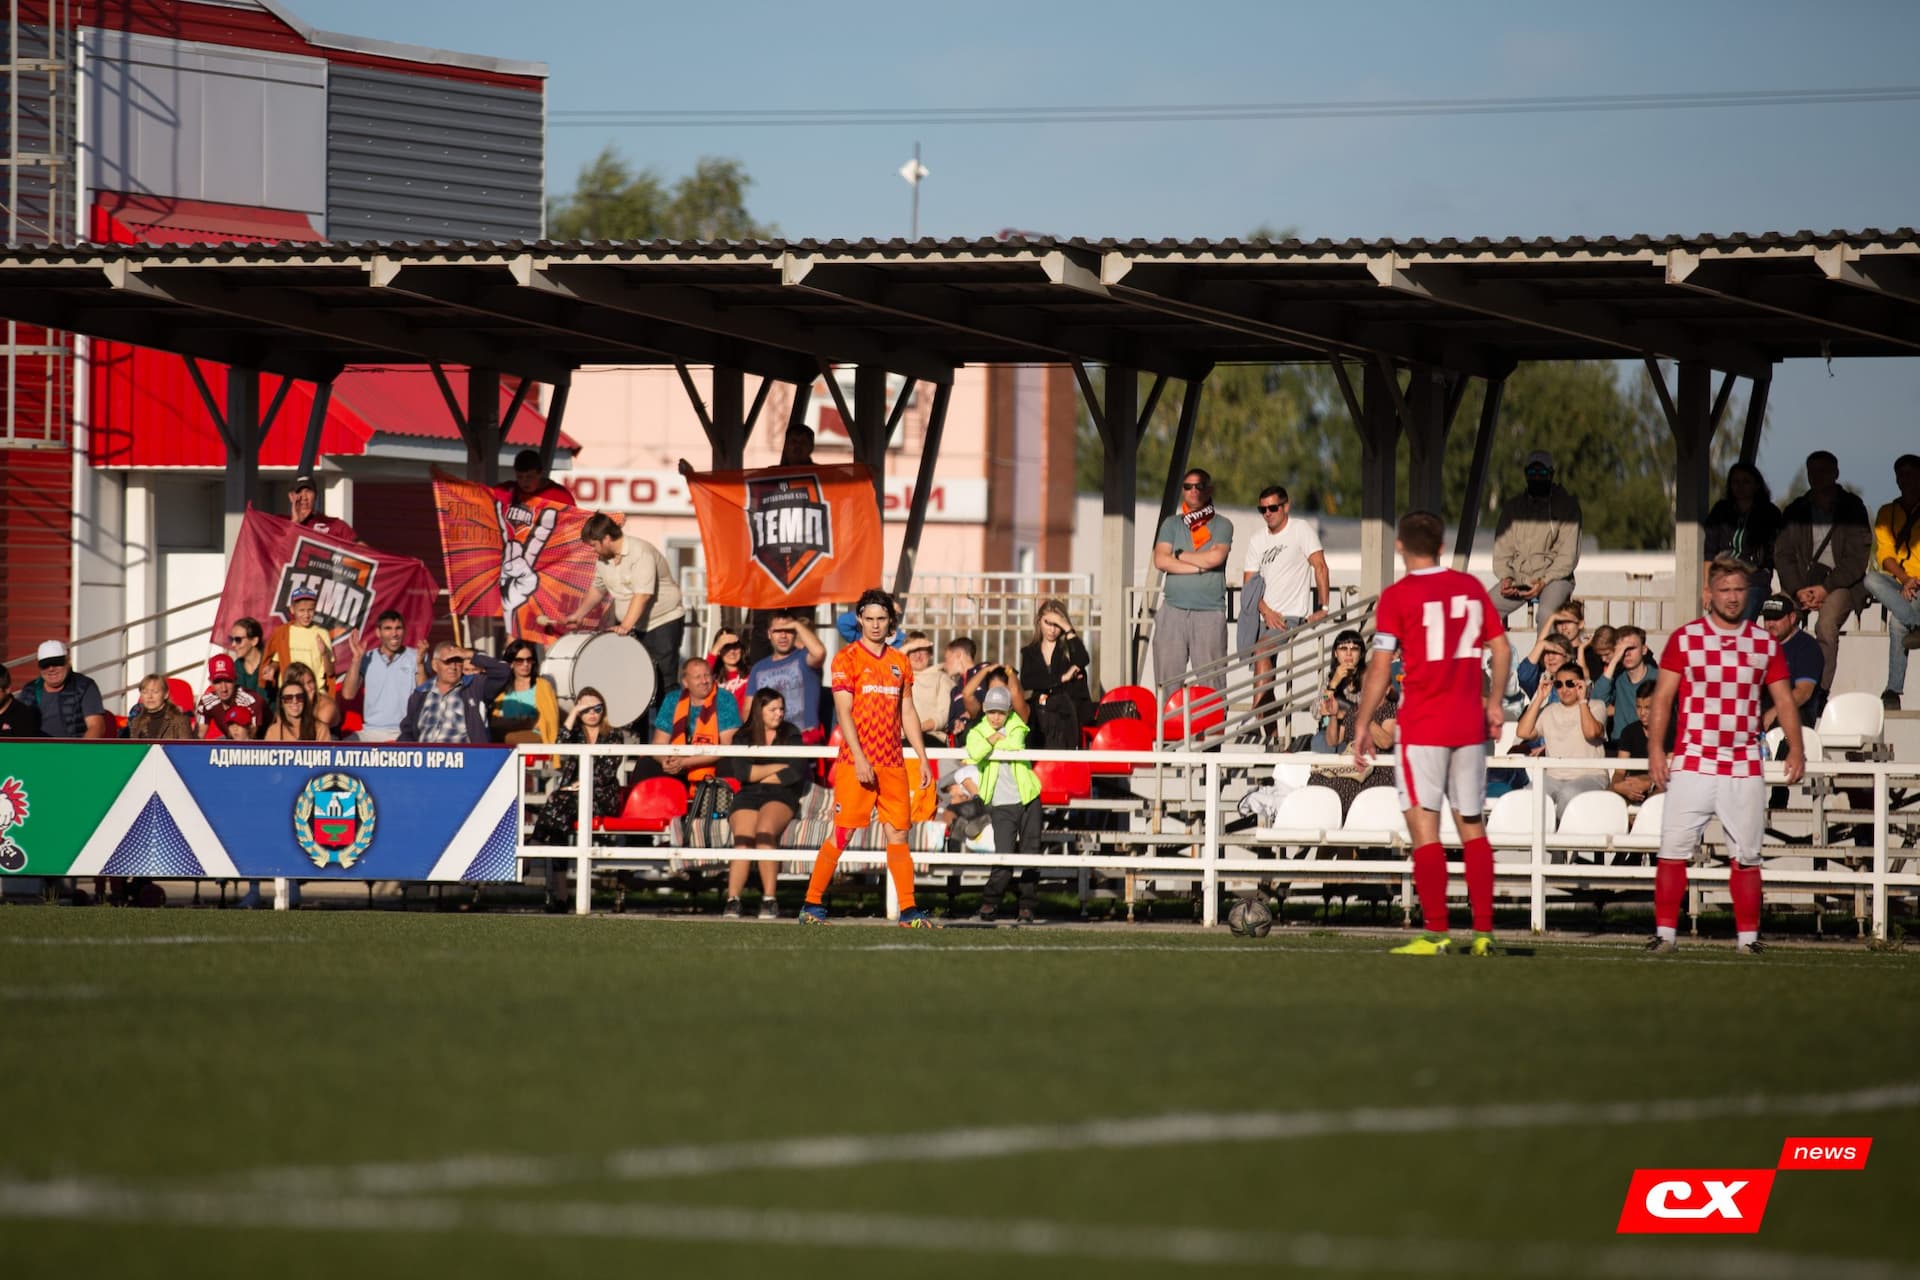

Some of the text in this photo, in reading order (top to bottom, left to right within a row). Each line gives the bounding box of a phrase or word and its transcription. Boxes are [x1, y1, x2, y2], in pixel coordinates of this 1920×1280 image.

[753, 507, 824, 548] ТЕМП
[1422, 594, 1484, 662] 12
[209, 748, 465, 768] АДМИНИСТРАЦИЯ АЛТАЙСКОГО КРАЯ
